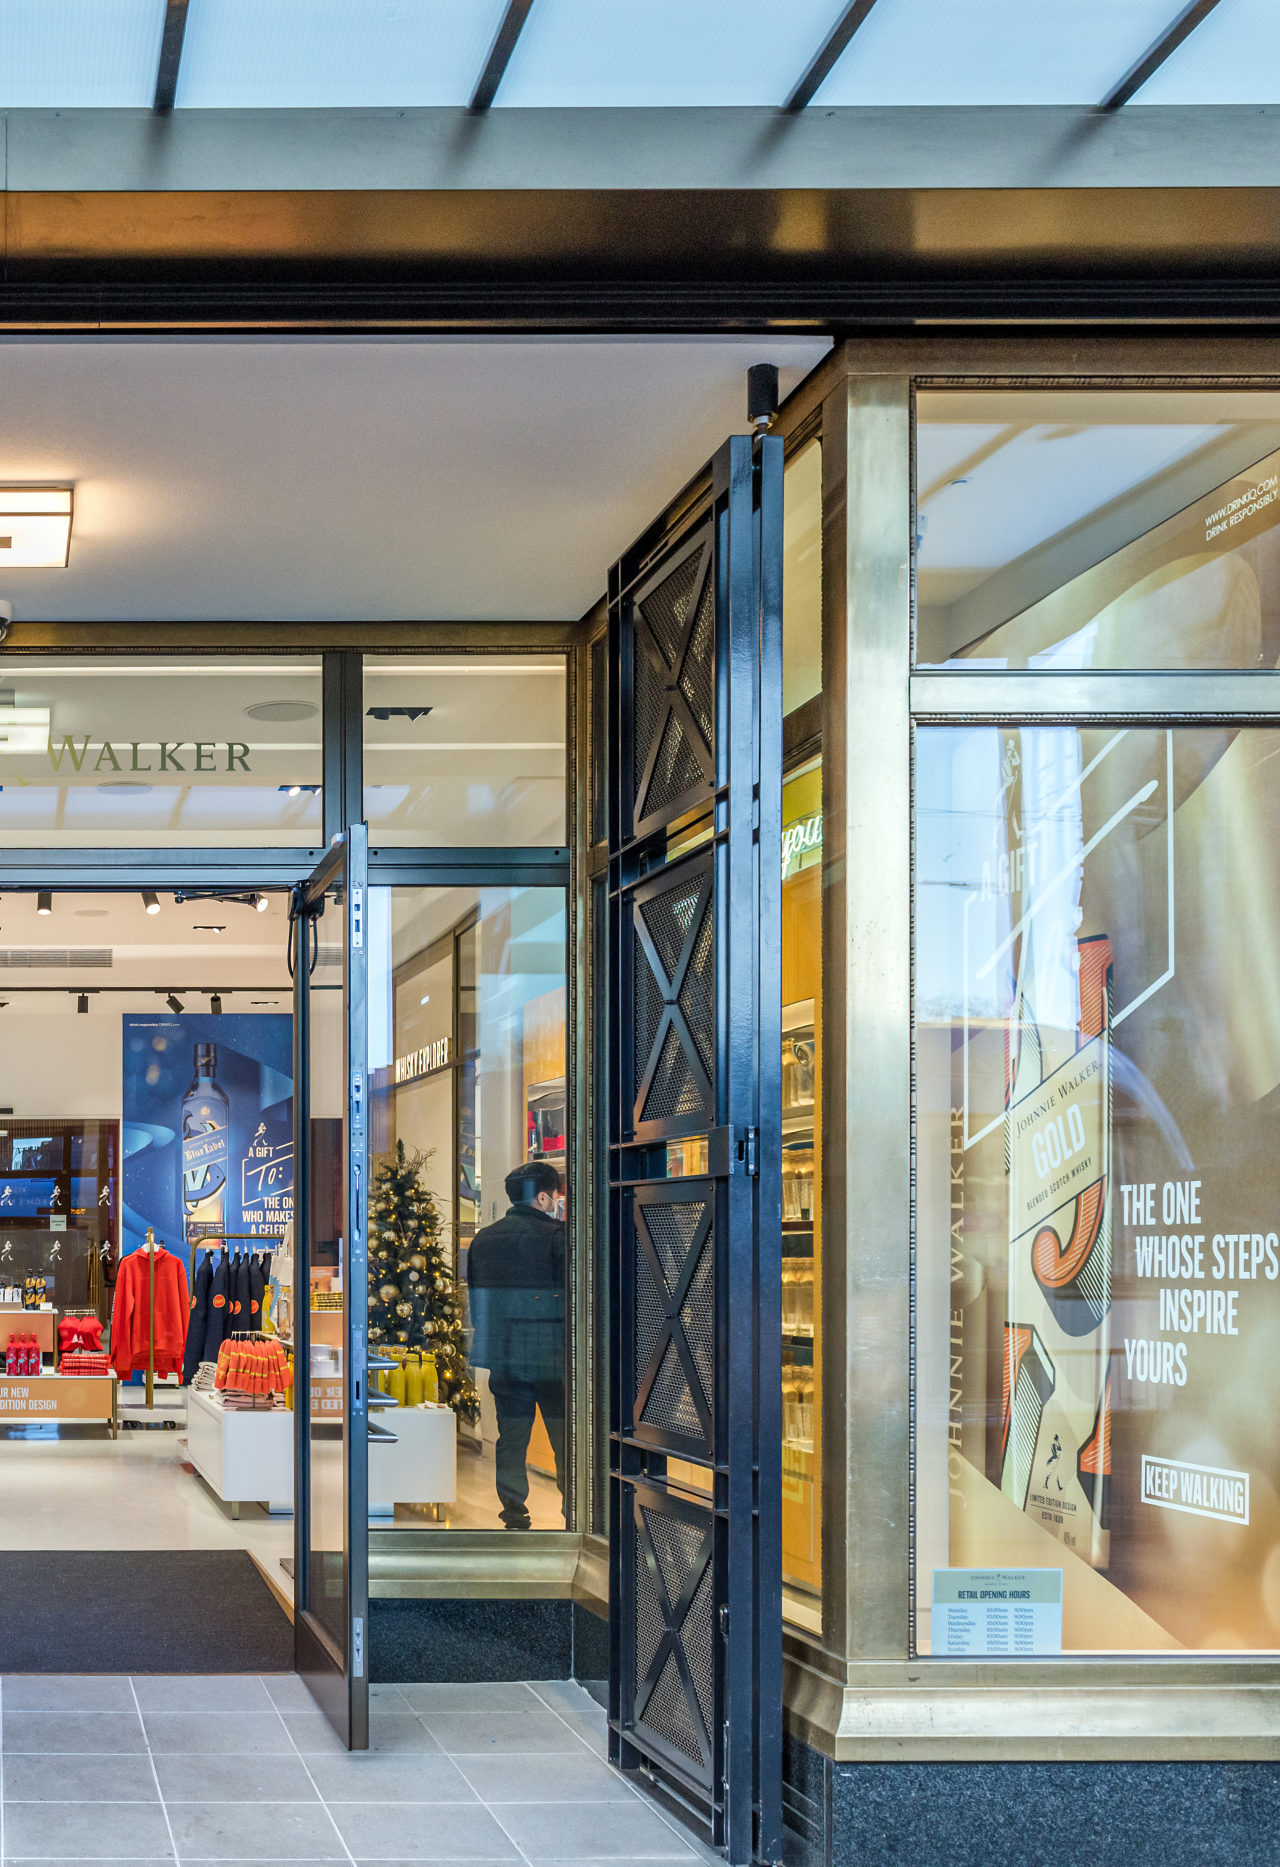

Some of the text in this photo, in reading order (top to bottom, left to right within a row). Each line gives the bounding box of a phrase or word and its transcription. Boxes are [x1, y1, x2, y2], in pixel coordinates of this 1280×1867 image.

[1206, 488, 1278, 541] DRINK RESPONSIBLY
[47, 734, 252, 772] WALKER
[999, 841, 1038, 898] GIFT
[395, 1037, 449, 1083] WHISKY EXPLORER
[1015, 1060, 1099, 1140] JOHNNIE WALKER
[204, 1139, 225, 1154] Label
[248, 1147, 274, 1158] A GIFT
[1032, 1103, 1086, 1179] GOLD
[263, 1196, 294, 1209] THE ON
[1026, 1156, 1093, 1211] BLENDED SCOTCH WHISKY
[1120, 1180, 1202, 1226] THE ONE
[242, 1210, 264, 1223] WHO
[250, 1224, 257, 1234] A
[1135, 1232, 1279, 1280] WHOSE STEPS
[949, 1105, 968, 1509] JOHNNIE WALKER
[1159, 1288, 1239, 1336] INSPIRE
[1124, 1338, 1188, 1387] YOURS
[10, 1387, 30, 1398] NEW
[28, 1399, 57, 1410] DESIGN
[1145, 1464, 1244, 1514] KEEP WALKING
[958, 1590, 1030, 1599] RETAIL OPENING HOURS
